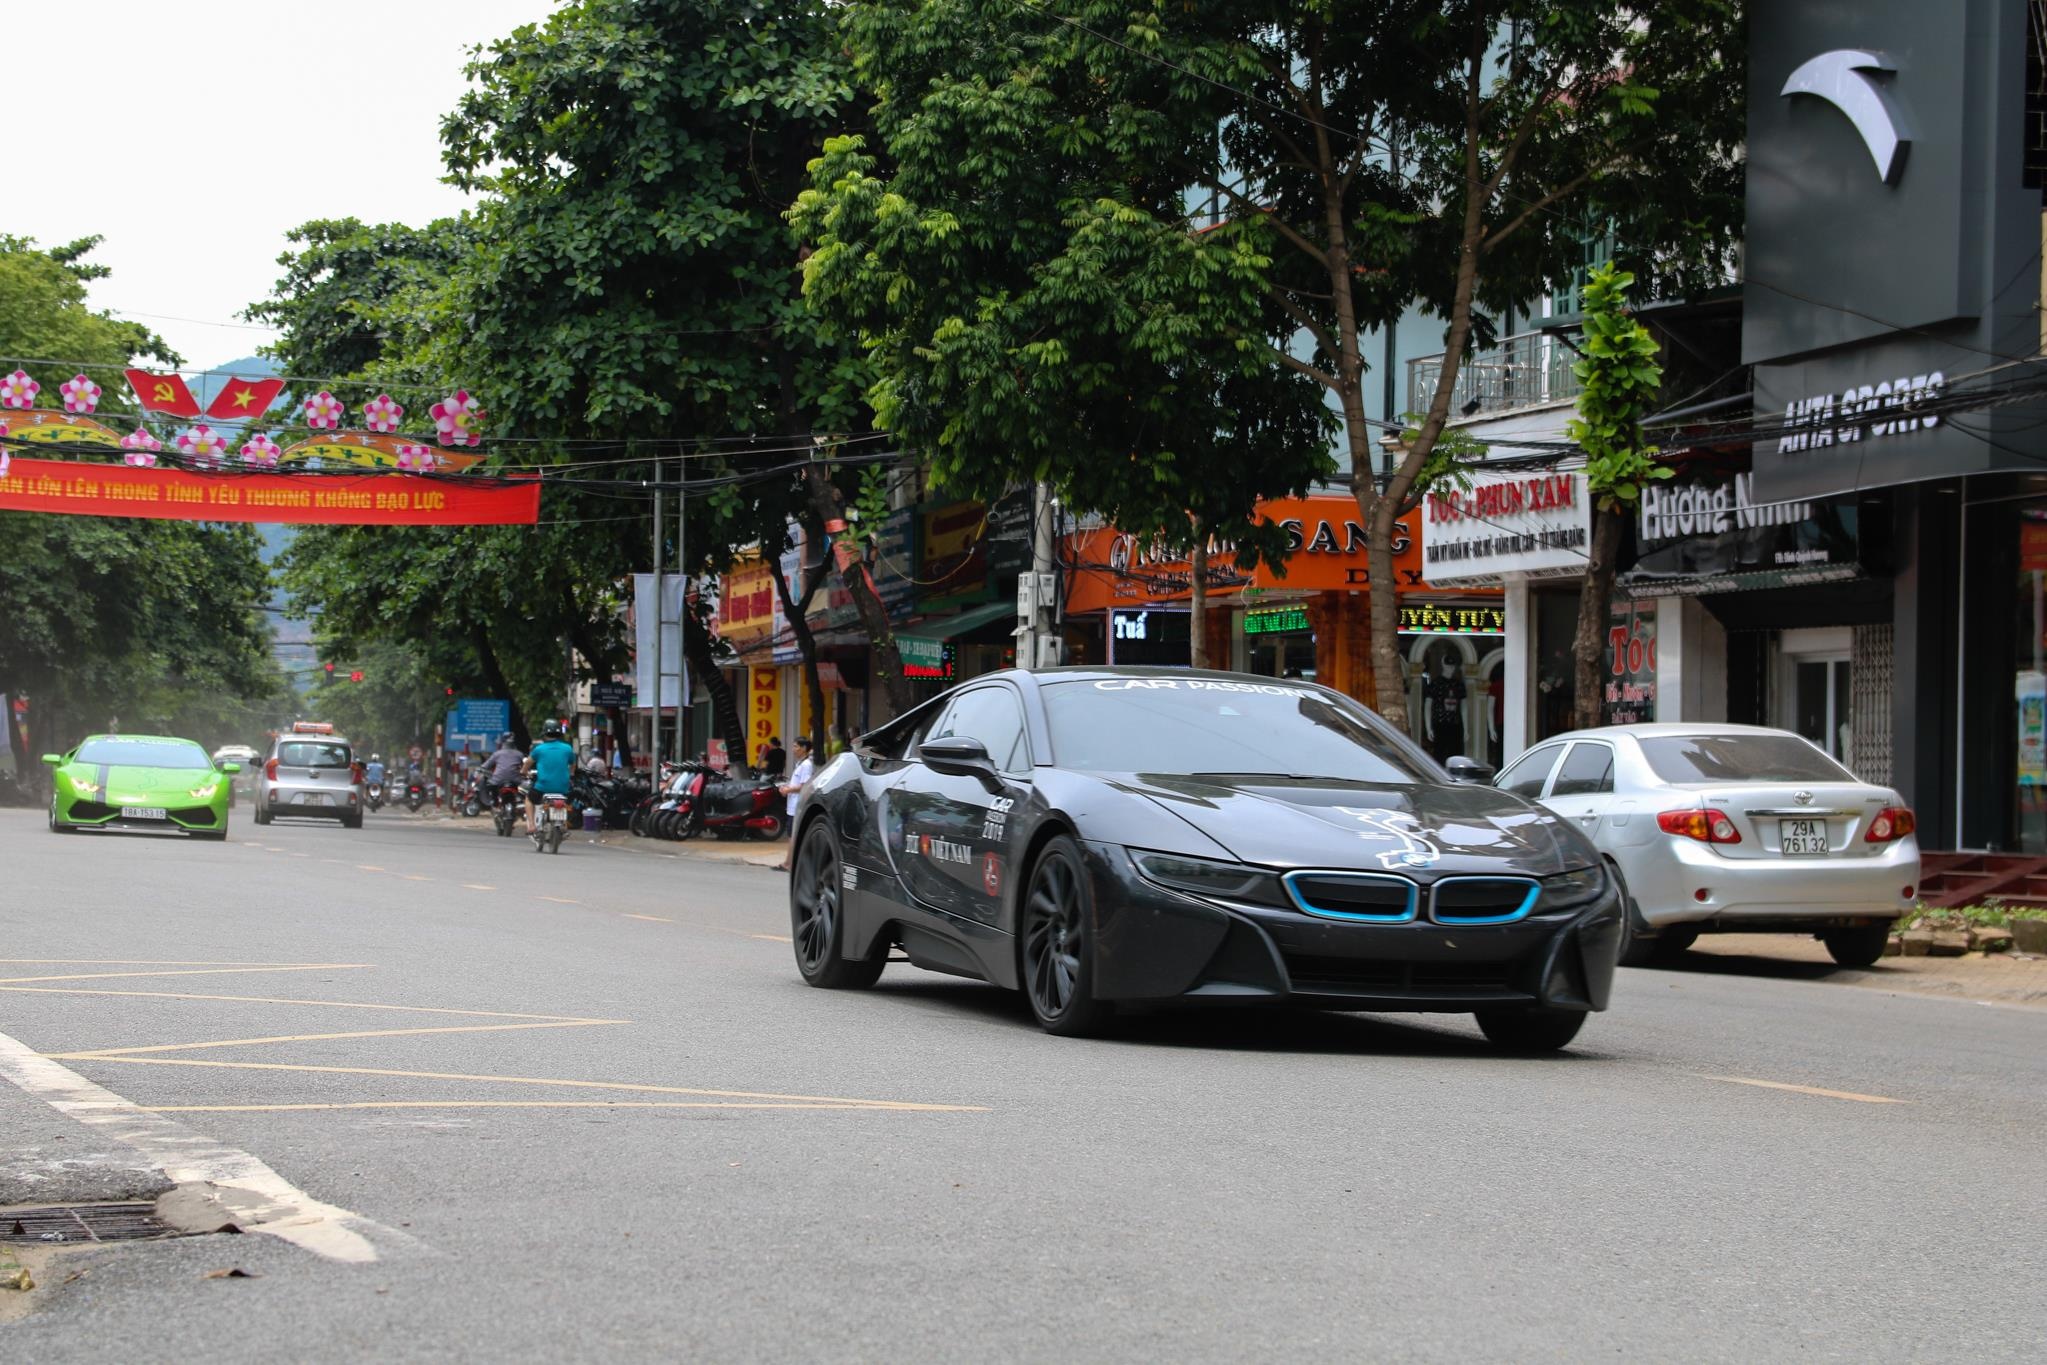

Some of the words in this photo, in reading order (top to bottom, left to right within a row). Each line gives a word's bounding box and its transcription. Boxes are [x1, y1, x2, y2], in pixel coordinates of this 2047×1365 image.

[66, 478, 99, 498] LÊN
[103, 482, 160, 501] TRONG
[165, 481, 204, 503] TÌNH
[208, 484, 240, 505] YÊU
[315, 487, 372, 509] KHÔNG
[376, 493, 409, 512] BẠO
[413, 491, 446, 512] LỰC
[1475, 480, 1523, 519] PHUN
[1094, 679, 1182, 691] CAR
[1185, 680, 1306, 699] PASSION
[1791, 821, 1816, 837] 29A
[950, 842, 972, 865] NAM
